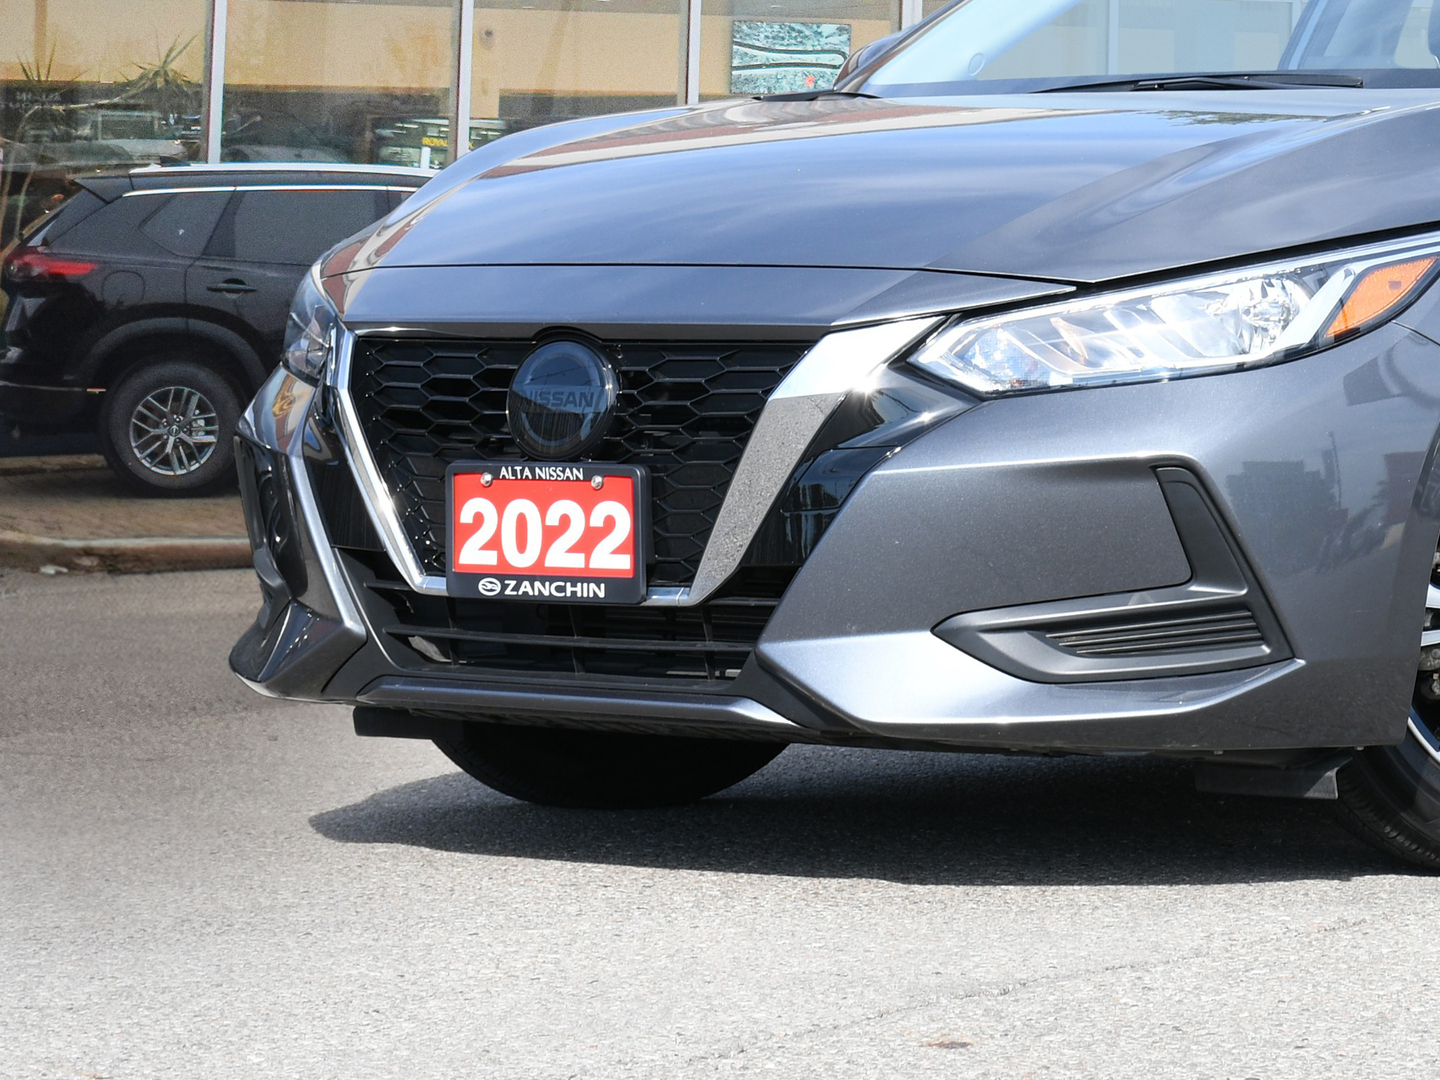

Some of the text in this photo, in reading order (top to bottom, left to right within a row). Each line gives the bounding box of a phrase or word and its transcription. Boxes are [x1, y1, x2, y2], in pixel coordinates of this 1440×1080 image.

[522, 390, 594, 408] NISSAN
[499, 465, 584, 481] ALTA NISSAN
[458, 497, 631, 570] 2022
[504, 579, 606, 599] ZANCHIN
